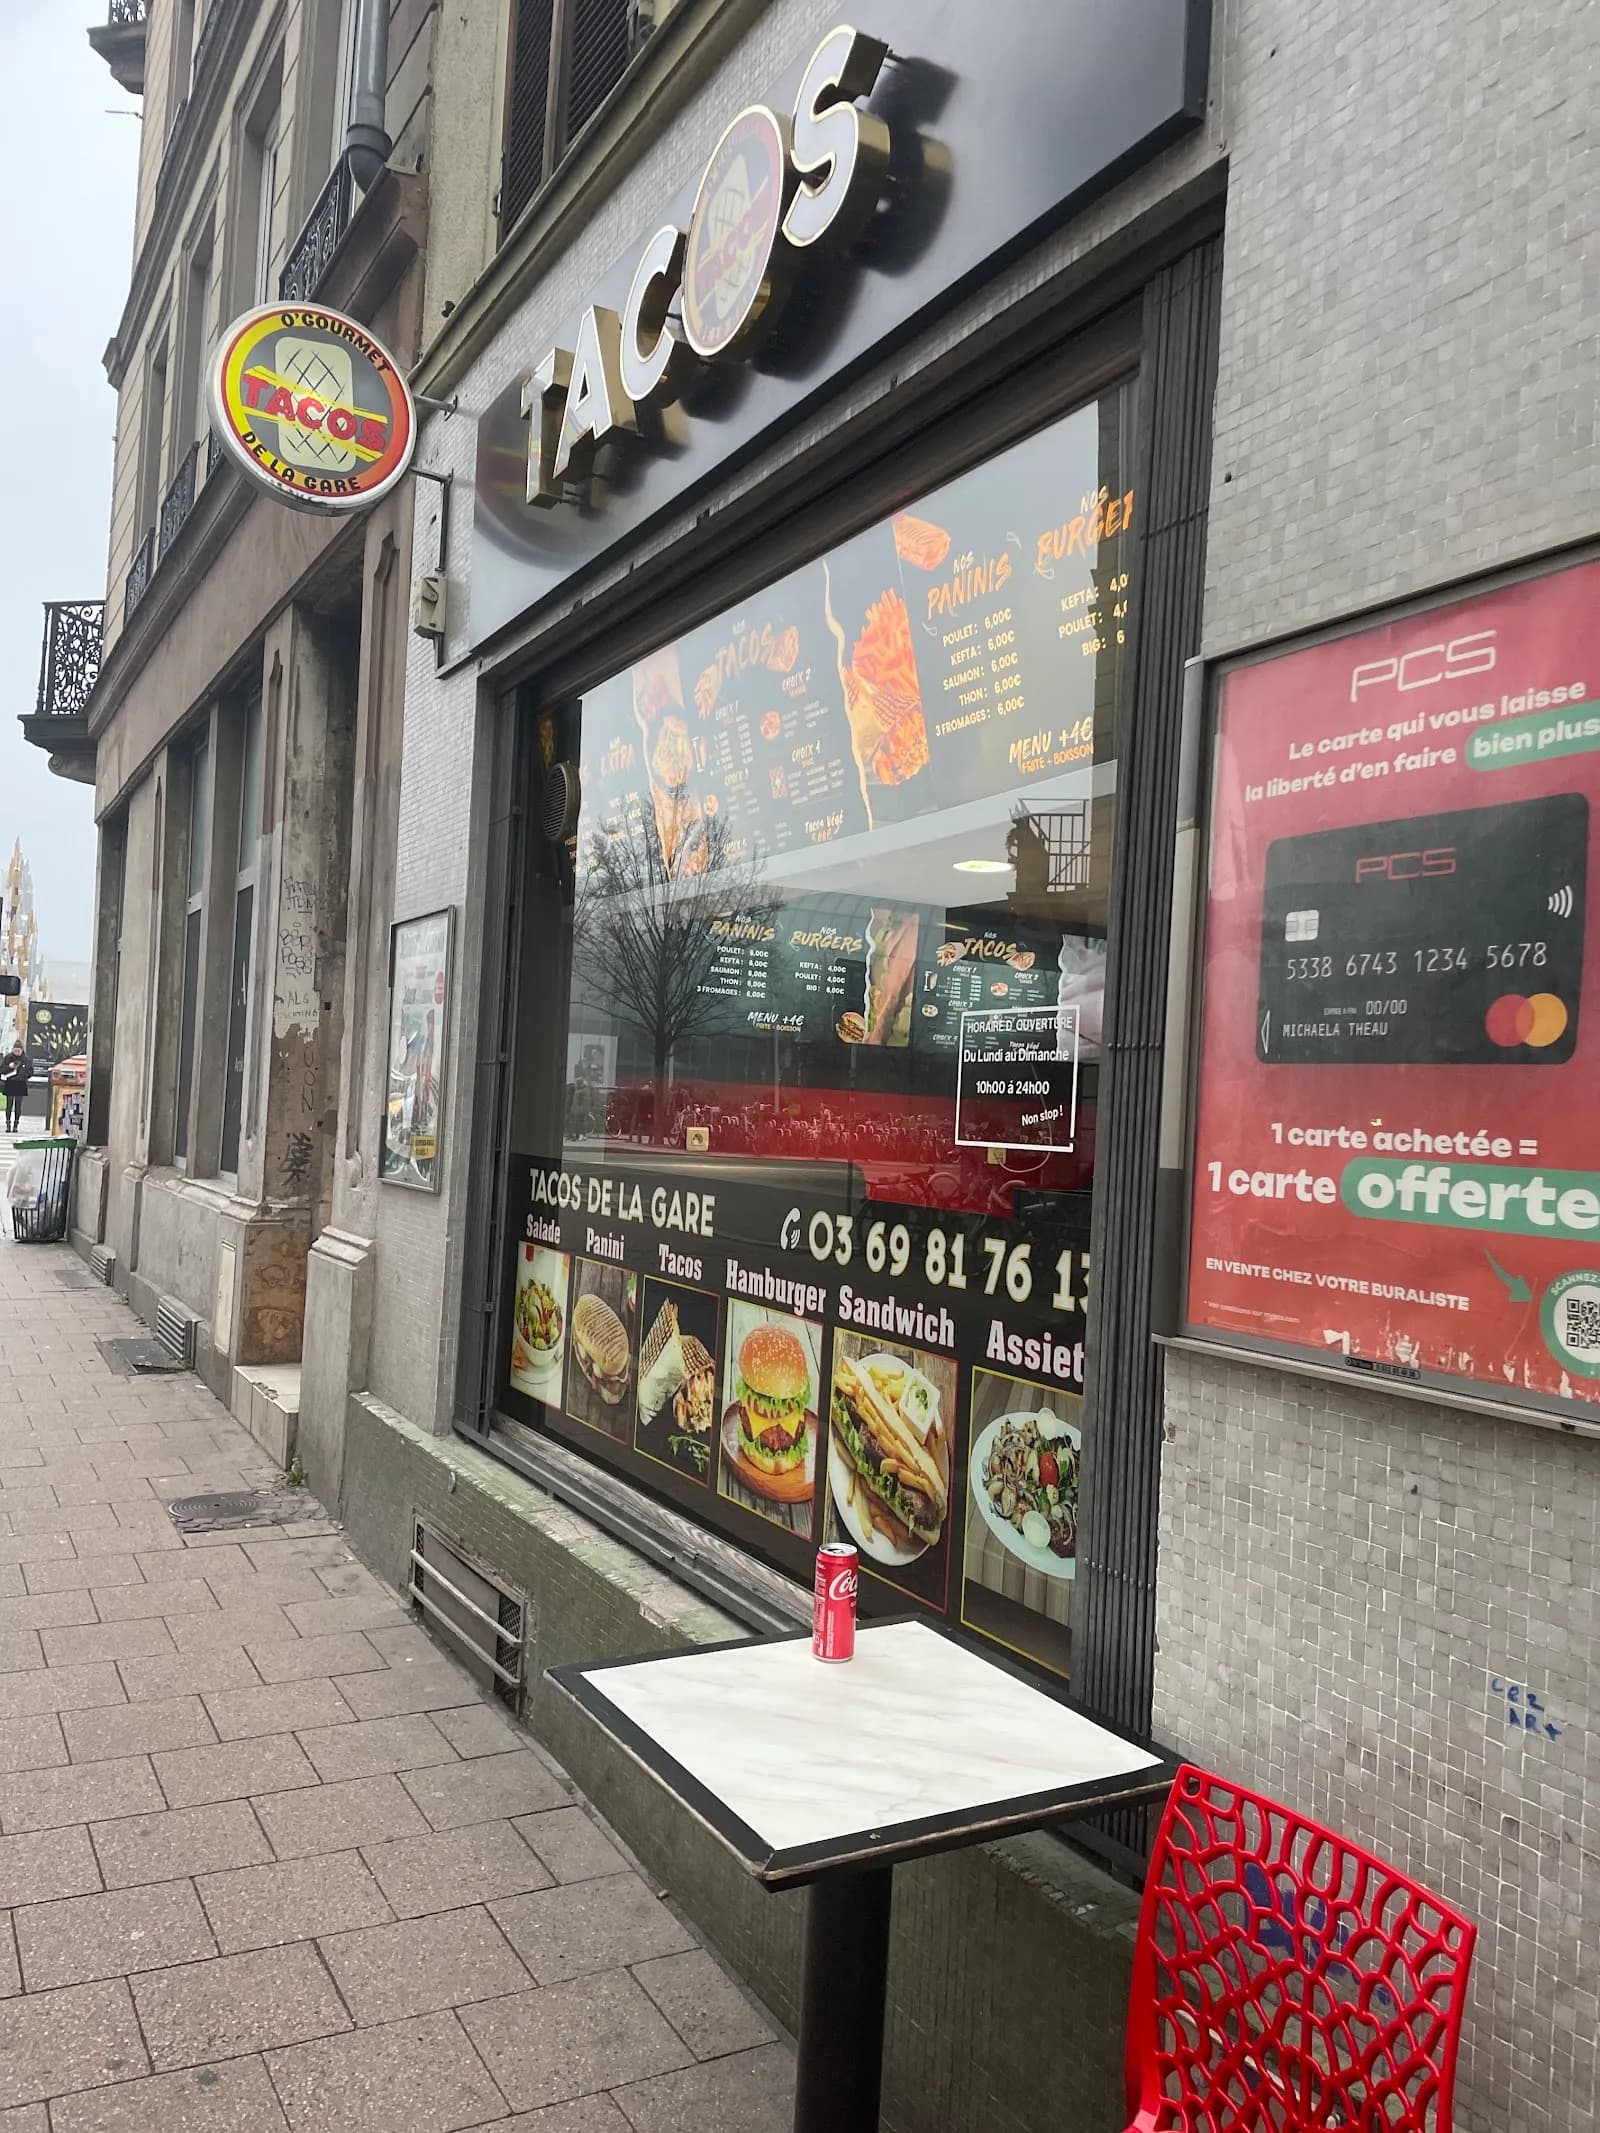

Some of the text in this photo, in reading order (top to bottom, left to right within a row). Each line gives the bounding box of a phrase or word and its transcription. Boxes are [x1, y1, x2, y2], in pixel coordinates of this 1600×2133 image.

[520, 24, 889, 508] TACOS
[281, 313, 390, 371] O'GOURMET
[242, 374, 386, 451] TACOS
[242, 431, 361, 491] DE LA GARE
[1080, 485, 1109, 514] NOS
[953, 551, 973, 575] NOS
[927, 552, 1012, 620] PANINIS
[715, 622, 775, 680] TACOS
[1350, 629, 1497, 703] PCS
[1288, 681, 1587, 761] Le carte qui vous laisse
[1009, 728, 1052, 764] MENU
[1245, 713, 1600, 802] la liberté d'en faire bien plus
[1355, 847, 1457, 883] PCS
[709, 920, 776, 942] PANINIS
[790, 930, 863, 954] BURGERS
[963, 937, 1018, 961] TACOS
[1287, 941, 1548, 980] 5338 6743 1234 5678
[747, 1011, 779, 1024] MENU
[1365, 999, 1408, 1016] 00/00
[1282, 1021, 1388, 1037] MICHAELA THEAU
[964, 1048, 1069, 1062] Du Lundi au Dimanche
[976, 1080, 1006, 1094] 10h00
[1016, 1081, 1050, 1094] 24h00
[1021, 1114, 1038, 1126] Non
[1040, 1108, 1059, 1122] stop
[1270, 1122, 1283, 1145] 1
[1287, 1125, 1367, 1150] carte
[1372, 1127, 1512, 1158] achetée
[529, 1168, 715, 1237] TACOS DE LA GARE
[1207, 1161, 1599, 1230] 1 carte offerte
[526, 1213, 561, 1245] Salade
[586, 1227, 625, 1261] Panini
[659, 1243, 703, 1281] Tacos
[808, 1210, 854, 1266] 03
[865, 1221, 910, 1277] 69
[924, 1227, 968, 1290] 81
[982, 1237, 1032, 1303] 76
[725, 1258, 827, 1317] Hamburger
[1206, 1257, 1470, 1312] EN VENTE CHEZ VOTRE BURALISTE
[838, 1284, 956, 1348] Sandwich
